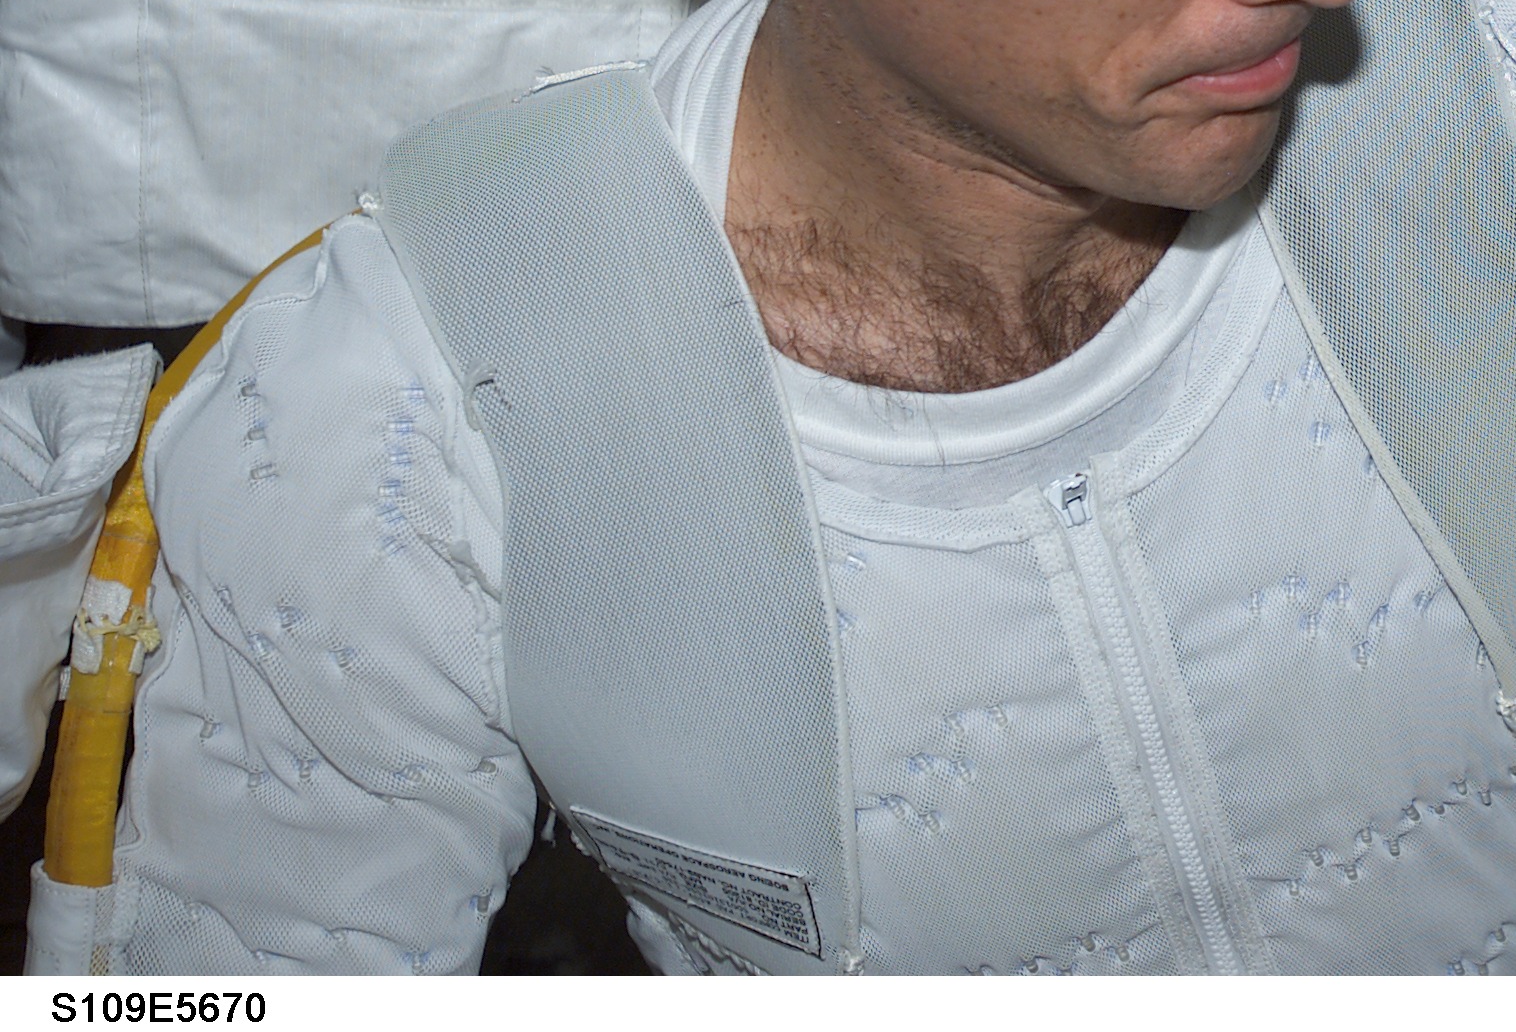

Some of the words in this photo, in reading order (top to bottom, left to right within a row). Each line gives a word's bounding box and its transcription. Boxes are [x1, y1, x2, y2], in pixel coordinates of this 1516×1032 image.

[681, 854, 745, 878] AEROSPACE
[748, 873, 790, 892] BOEING
[741, 887, 802, 910] CONTRACT
